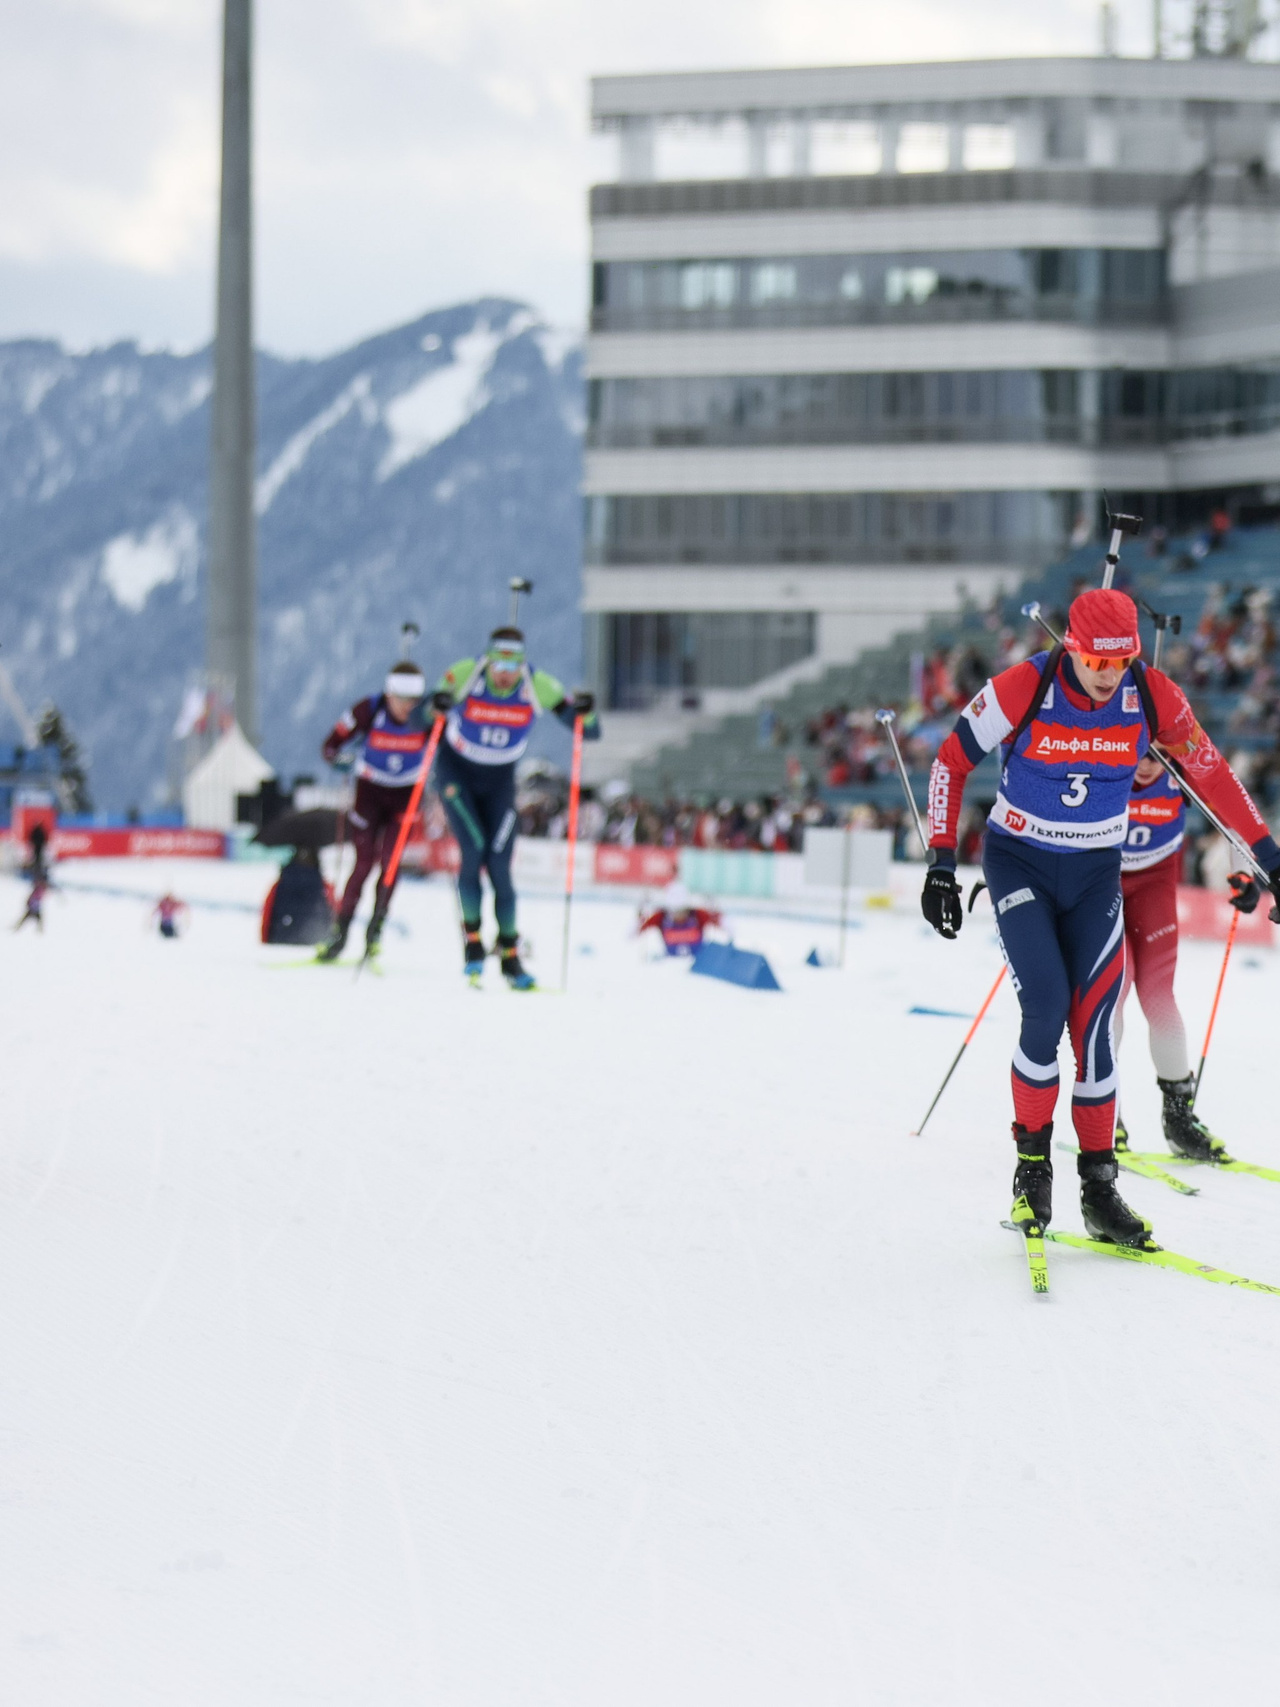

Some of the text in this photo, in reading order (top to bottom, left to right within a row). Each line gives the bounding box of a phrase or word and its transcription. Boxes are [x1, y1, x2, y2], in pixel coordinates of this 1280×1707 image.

[480, 725, 511, 748] 10
[1037, 736, 1130, 754] Альфа Банк
[1061, 773, 1091, 807] 3
